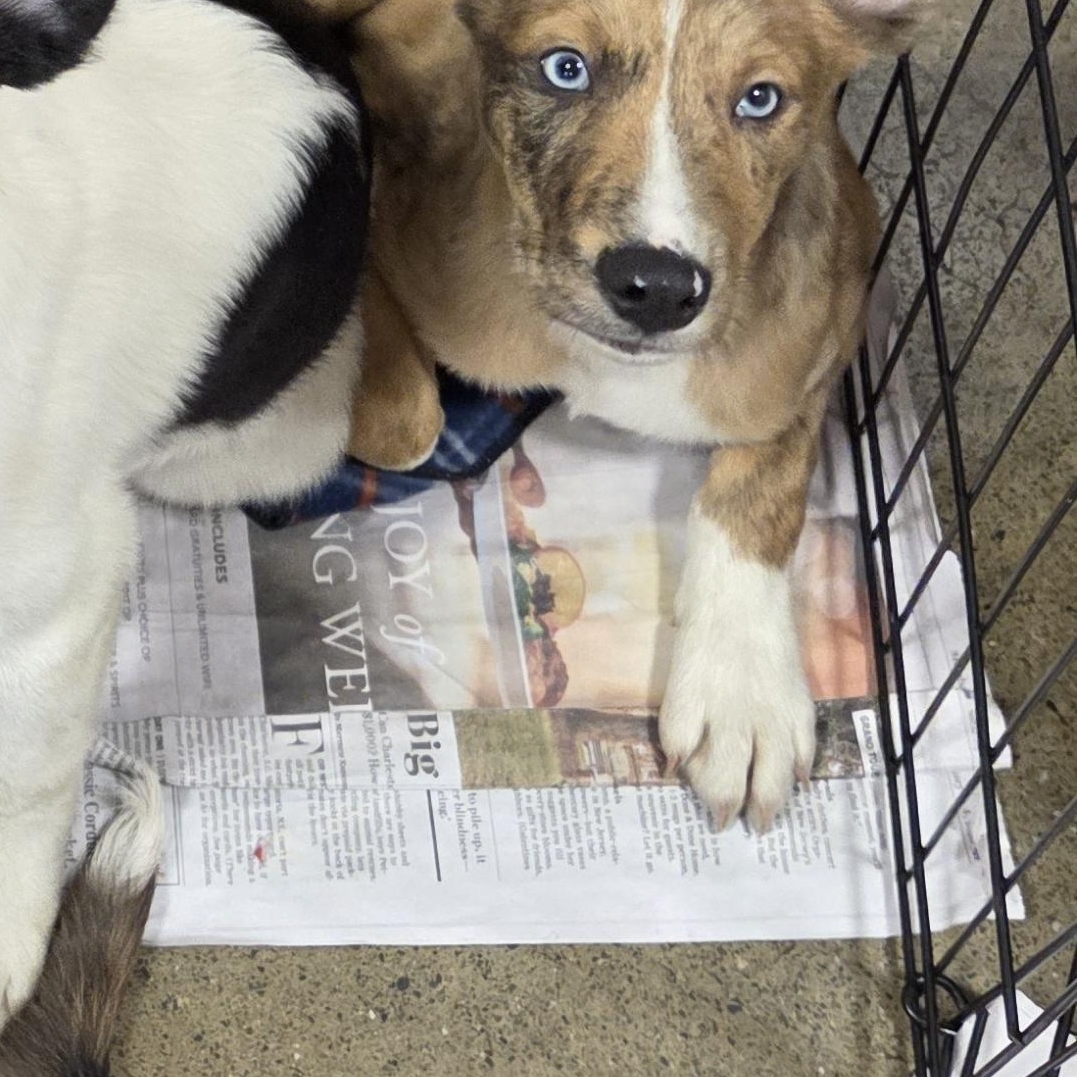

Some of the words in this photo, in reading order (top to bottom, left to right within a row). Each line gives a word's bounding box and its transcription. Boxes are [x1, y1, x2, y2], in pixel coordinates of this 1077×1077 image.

[189, 529, 204, 590] GRATUITIES
[211, 507, 228, 584] INCLUDES
[370, 501, 431, 598] JOY
[137, 602, 150, 643] CHOICE
[195, 603, 210, 661] UNLIMITED
[379, 614, 445, 665] of
[268, 714, 325, 756] F
[403, 711, 441, 779] Big
[465, 807, 483, 829] pile
[466, 792, 478, 804] to
[469, 832, 483, 852] up,
[474, 854, 486, 863] it
